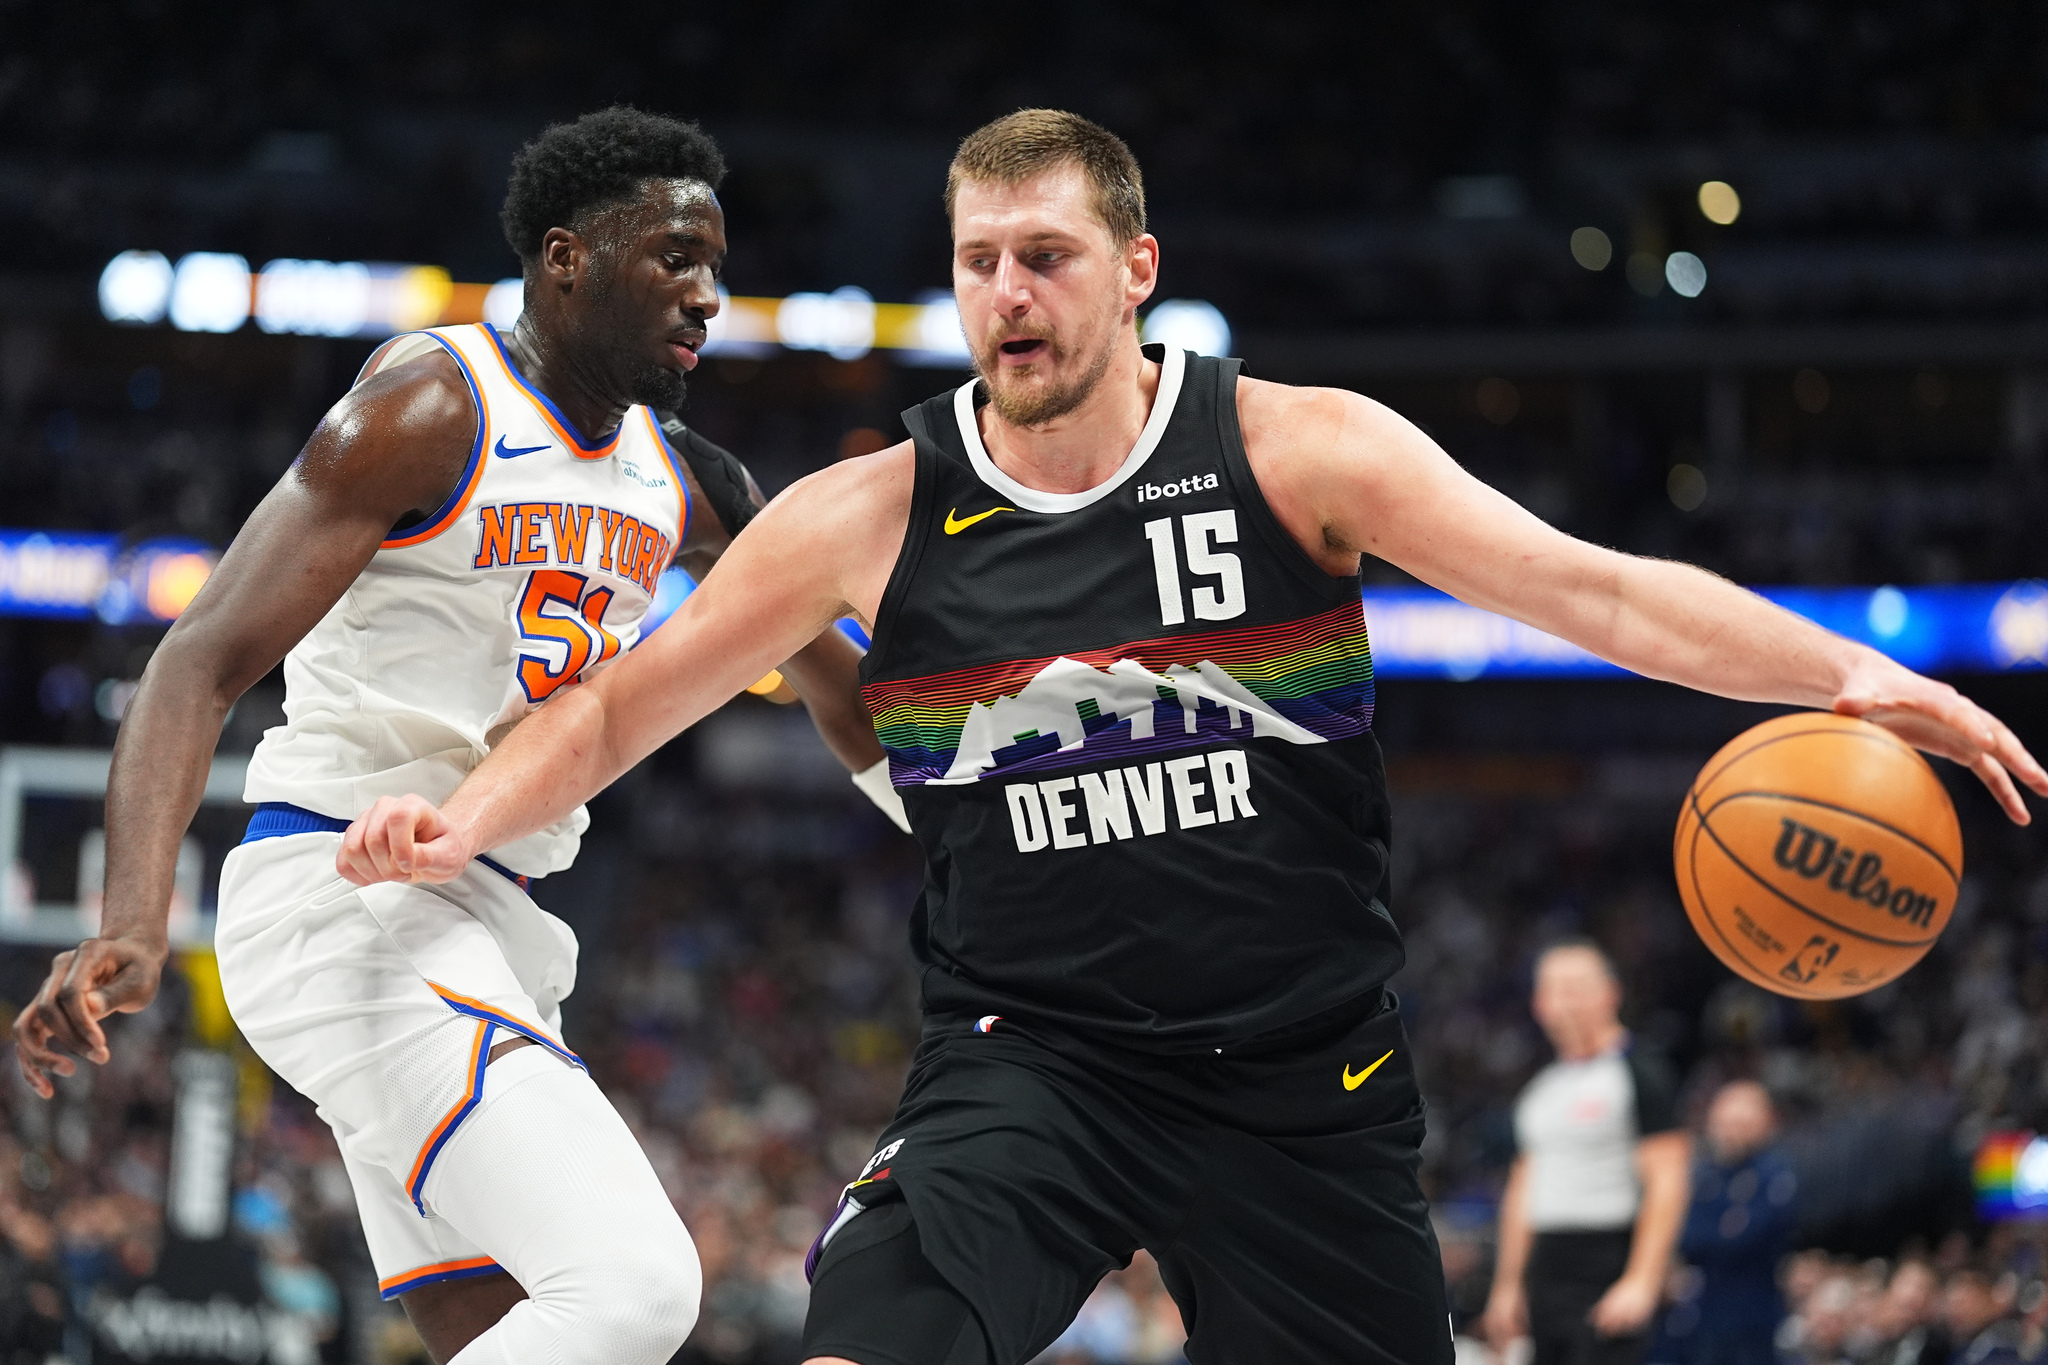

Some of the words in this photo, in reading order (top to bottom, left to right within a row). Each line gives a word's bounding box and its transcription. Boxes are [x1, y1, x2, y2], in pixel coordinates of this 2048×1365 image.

[1137, 472, 1219, 503] ibotta
[472, 502, 594, 570] NEW
[597, 506, 670, 600] YORK
[1144, 509, 1247, 626] 15
[1004, 749, 1259, 853] DENVER
[1772, 816, 1938, 929] Wilson
